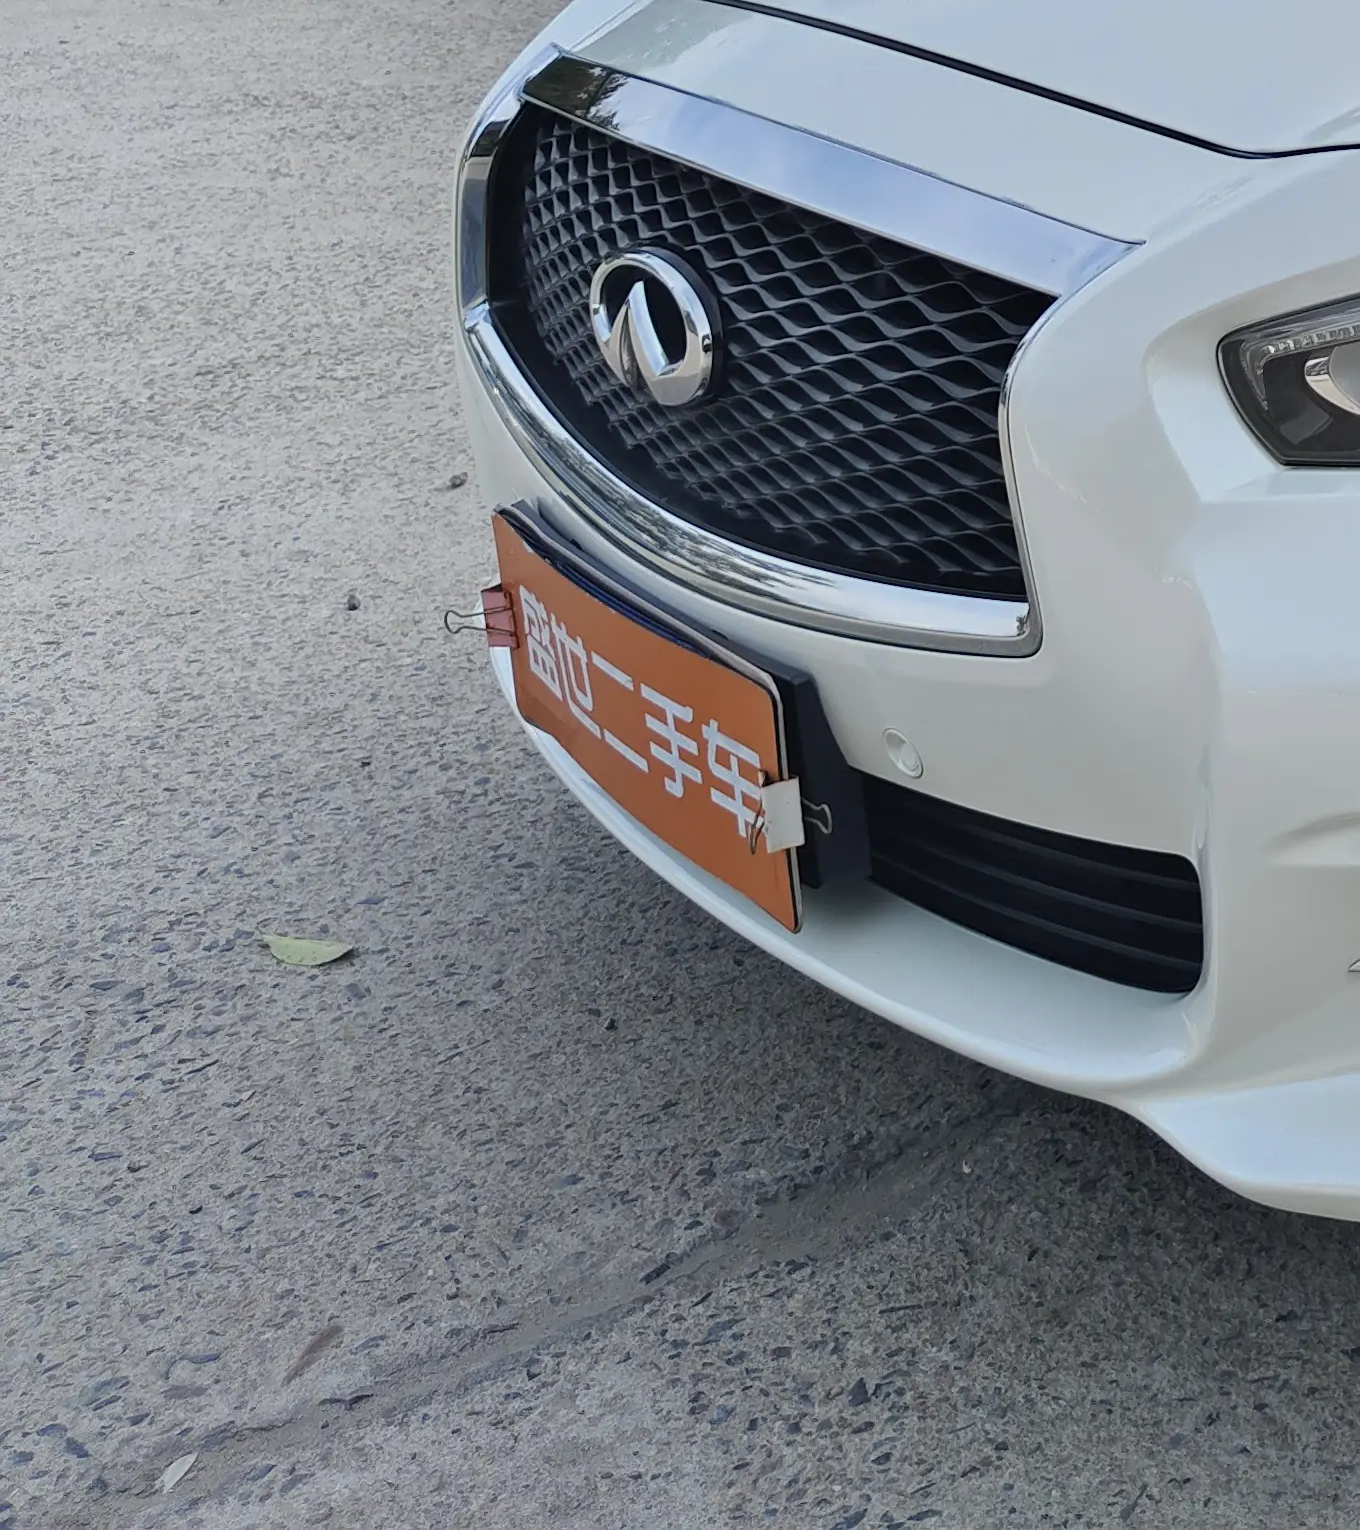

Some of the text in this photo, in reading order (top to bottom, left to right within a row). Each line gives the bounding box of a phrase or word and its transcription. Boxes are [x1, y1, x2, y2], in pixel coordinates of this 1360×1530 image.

[519, 584, 765, 838] 盛世二手车
